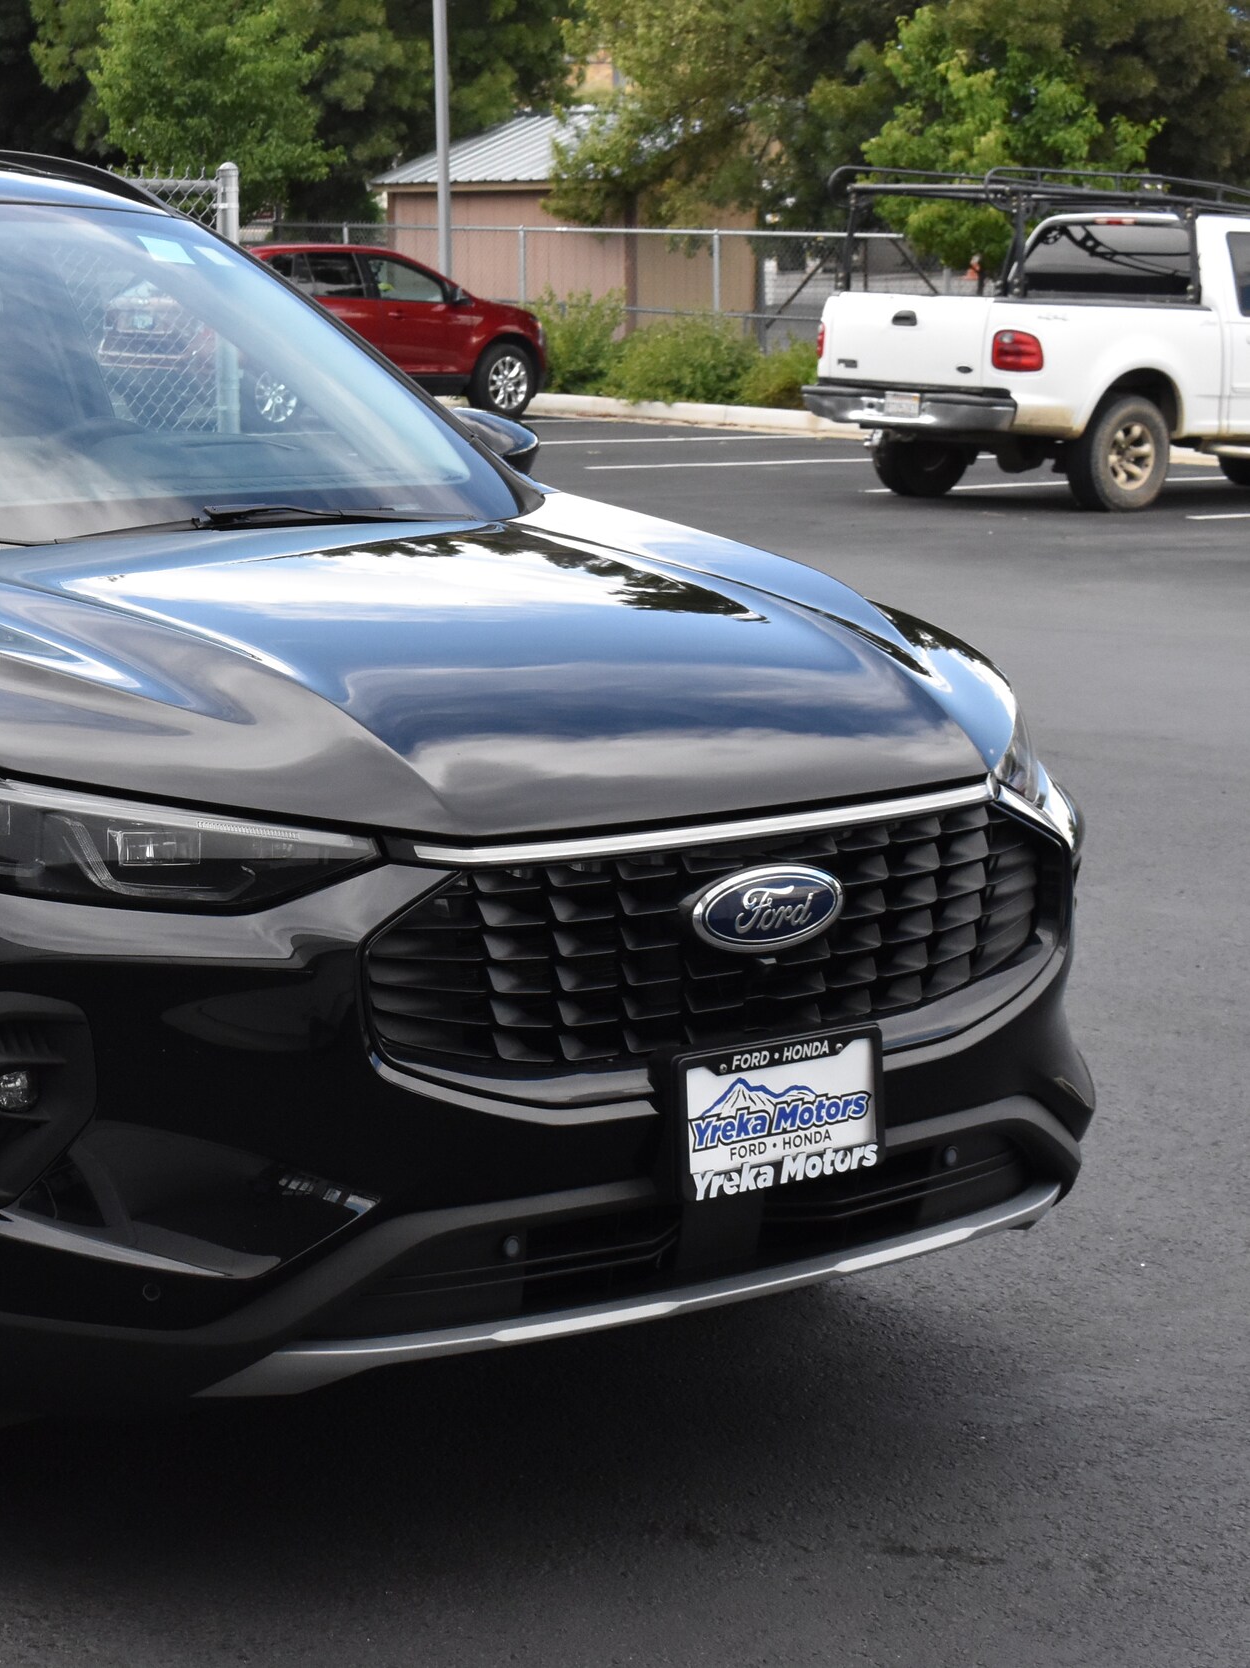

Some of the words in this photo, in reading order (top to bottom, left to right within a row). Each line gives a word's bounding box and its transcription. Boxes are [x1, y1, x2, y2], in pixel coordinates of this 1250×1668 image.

[734, 885, 813, 934] Ford
[731, 1050, 770, 1071] FORD
[782, 1040, 830, 1061] HONDA
[693, 1110, 768, 1148] Yreka
[773, 1094, 868, 1131] Motors
[729, 1141, 767, 1161] FORD
[782, 1129, 832, 1150] HONDA
[692, 1162, 774, 1201] Yreka
[780, 1143, 878, 1185] Motors
